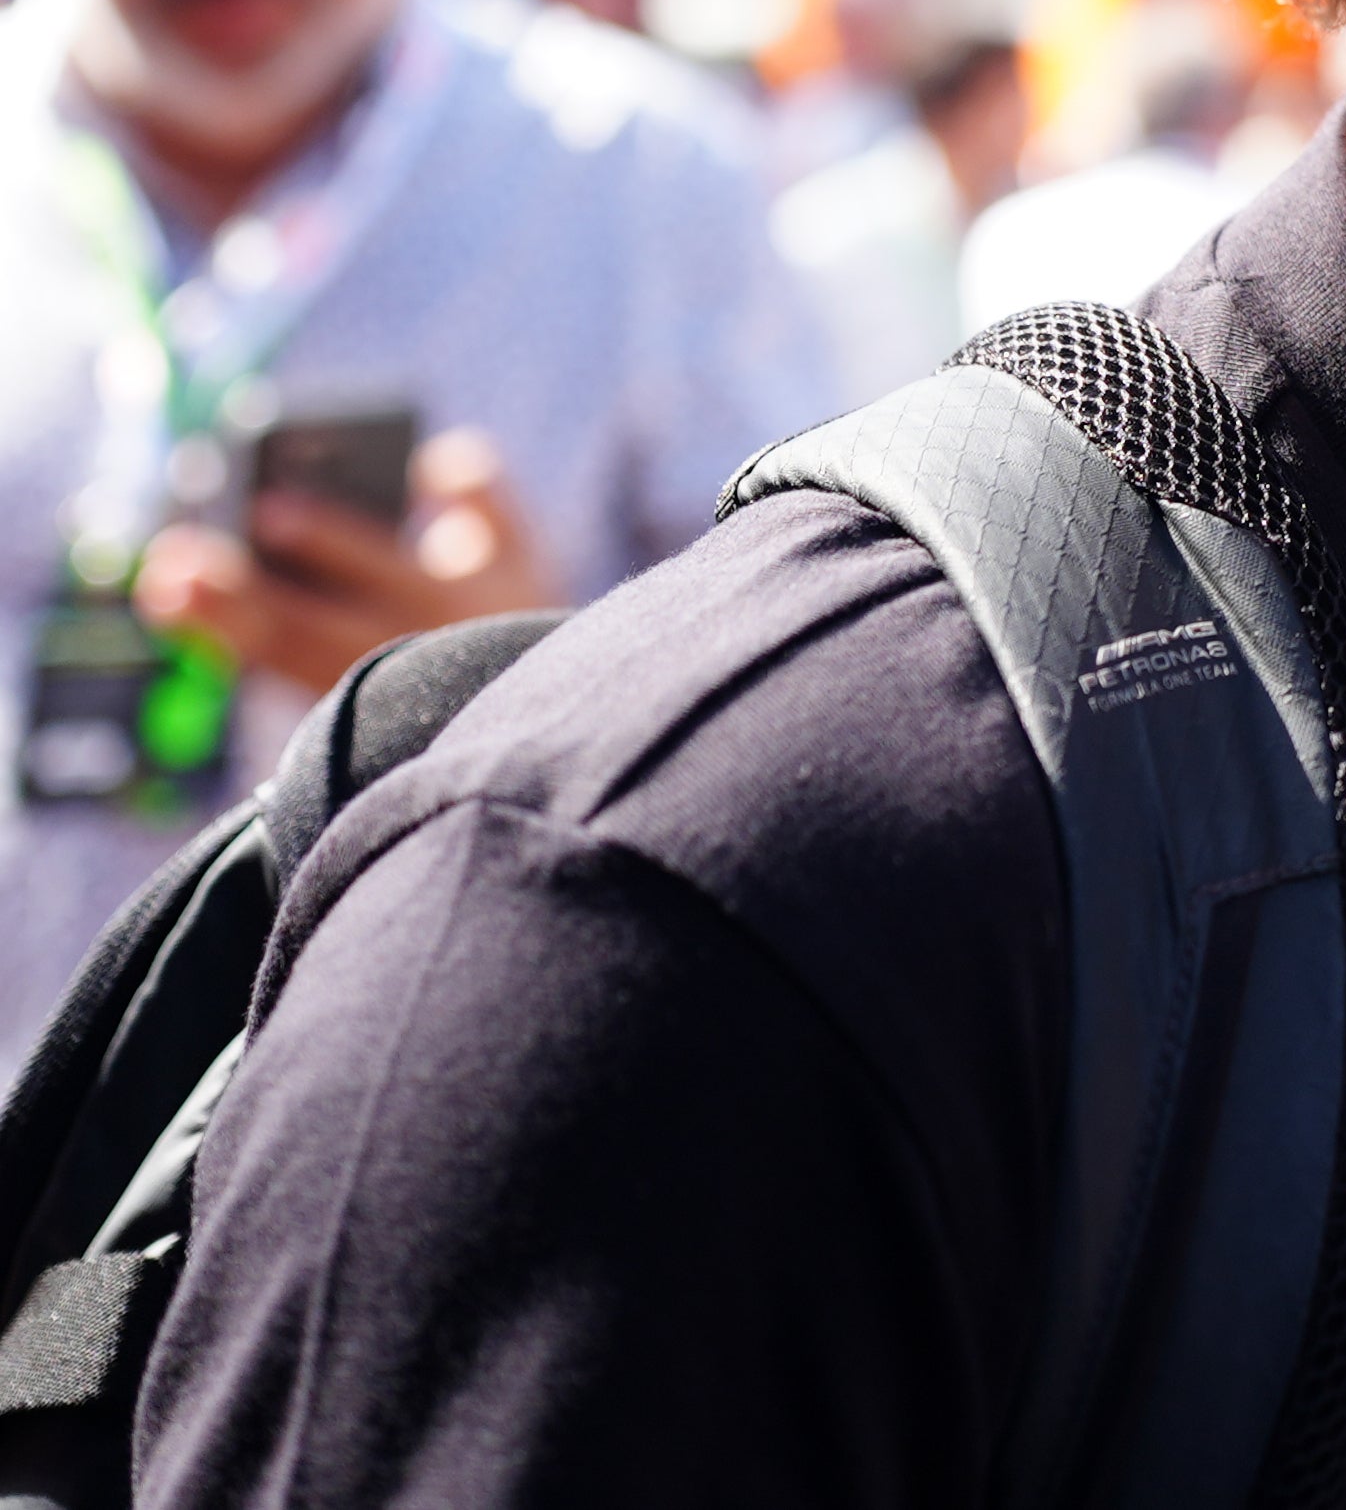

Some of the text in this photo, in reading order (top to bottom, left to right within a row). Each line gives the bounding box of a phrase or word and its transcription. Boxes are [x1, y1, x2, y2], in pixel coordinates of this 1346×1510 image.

[1078, 641, 1228, 695] PETRONAS
[1088, 662, 1239, 714] FORMULA ONE TEAM
